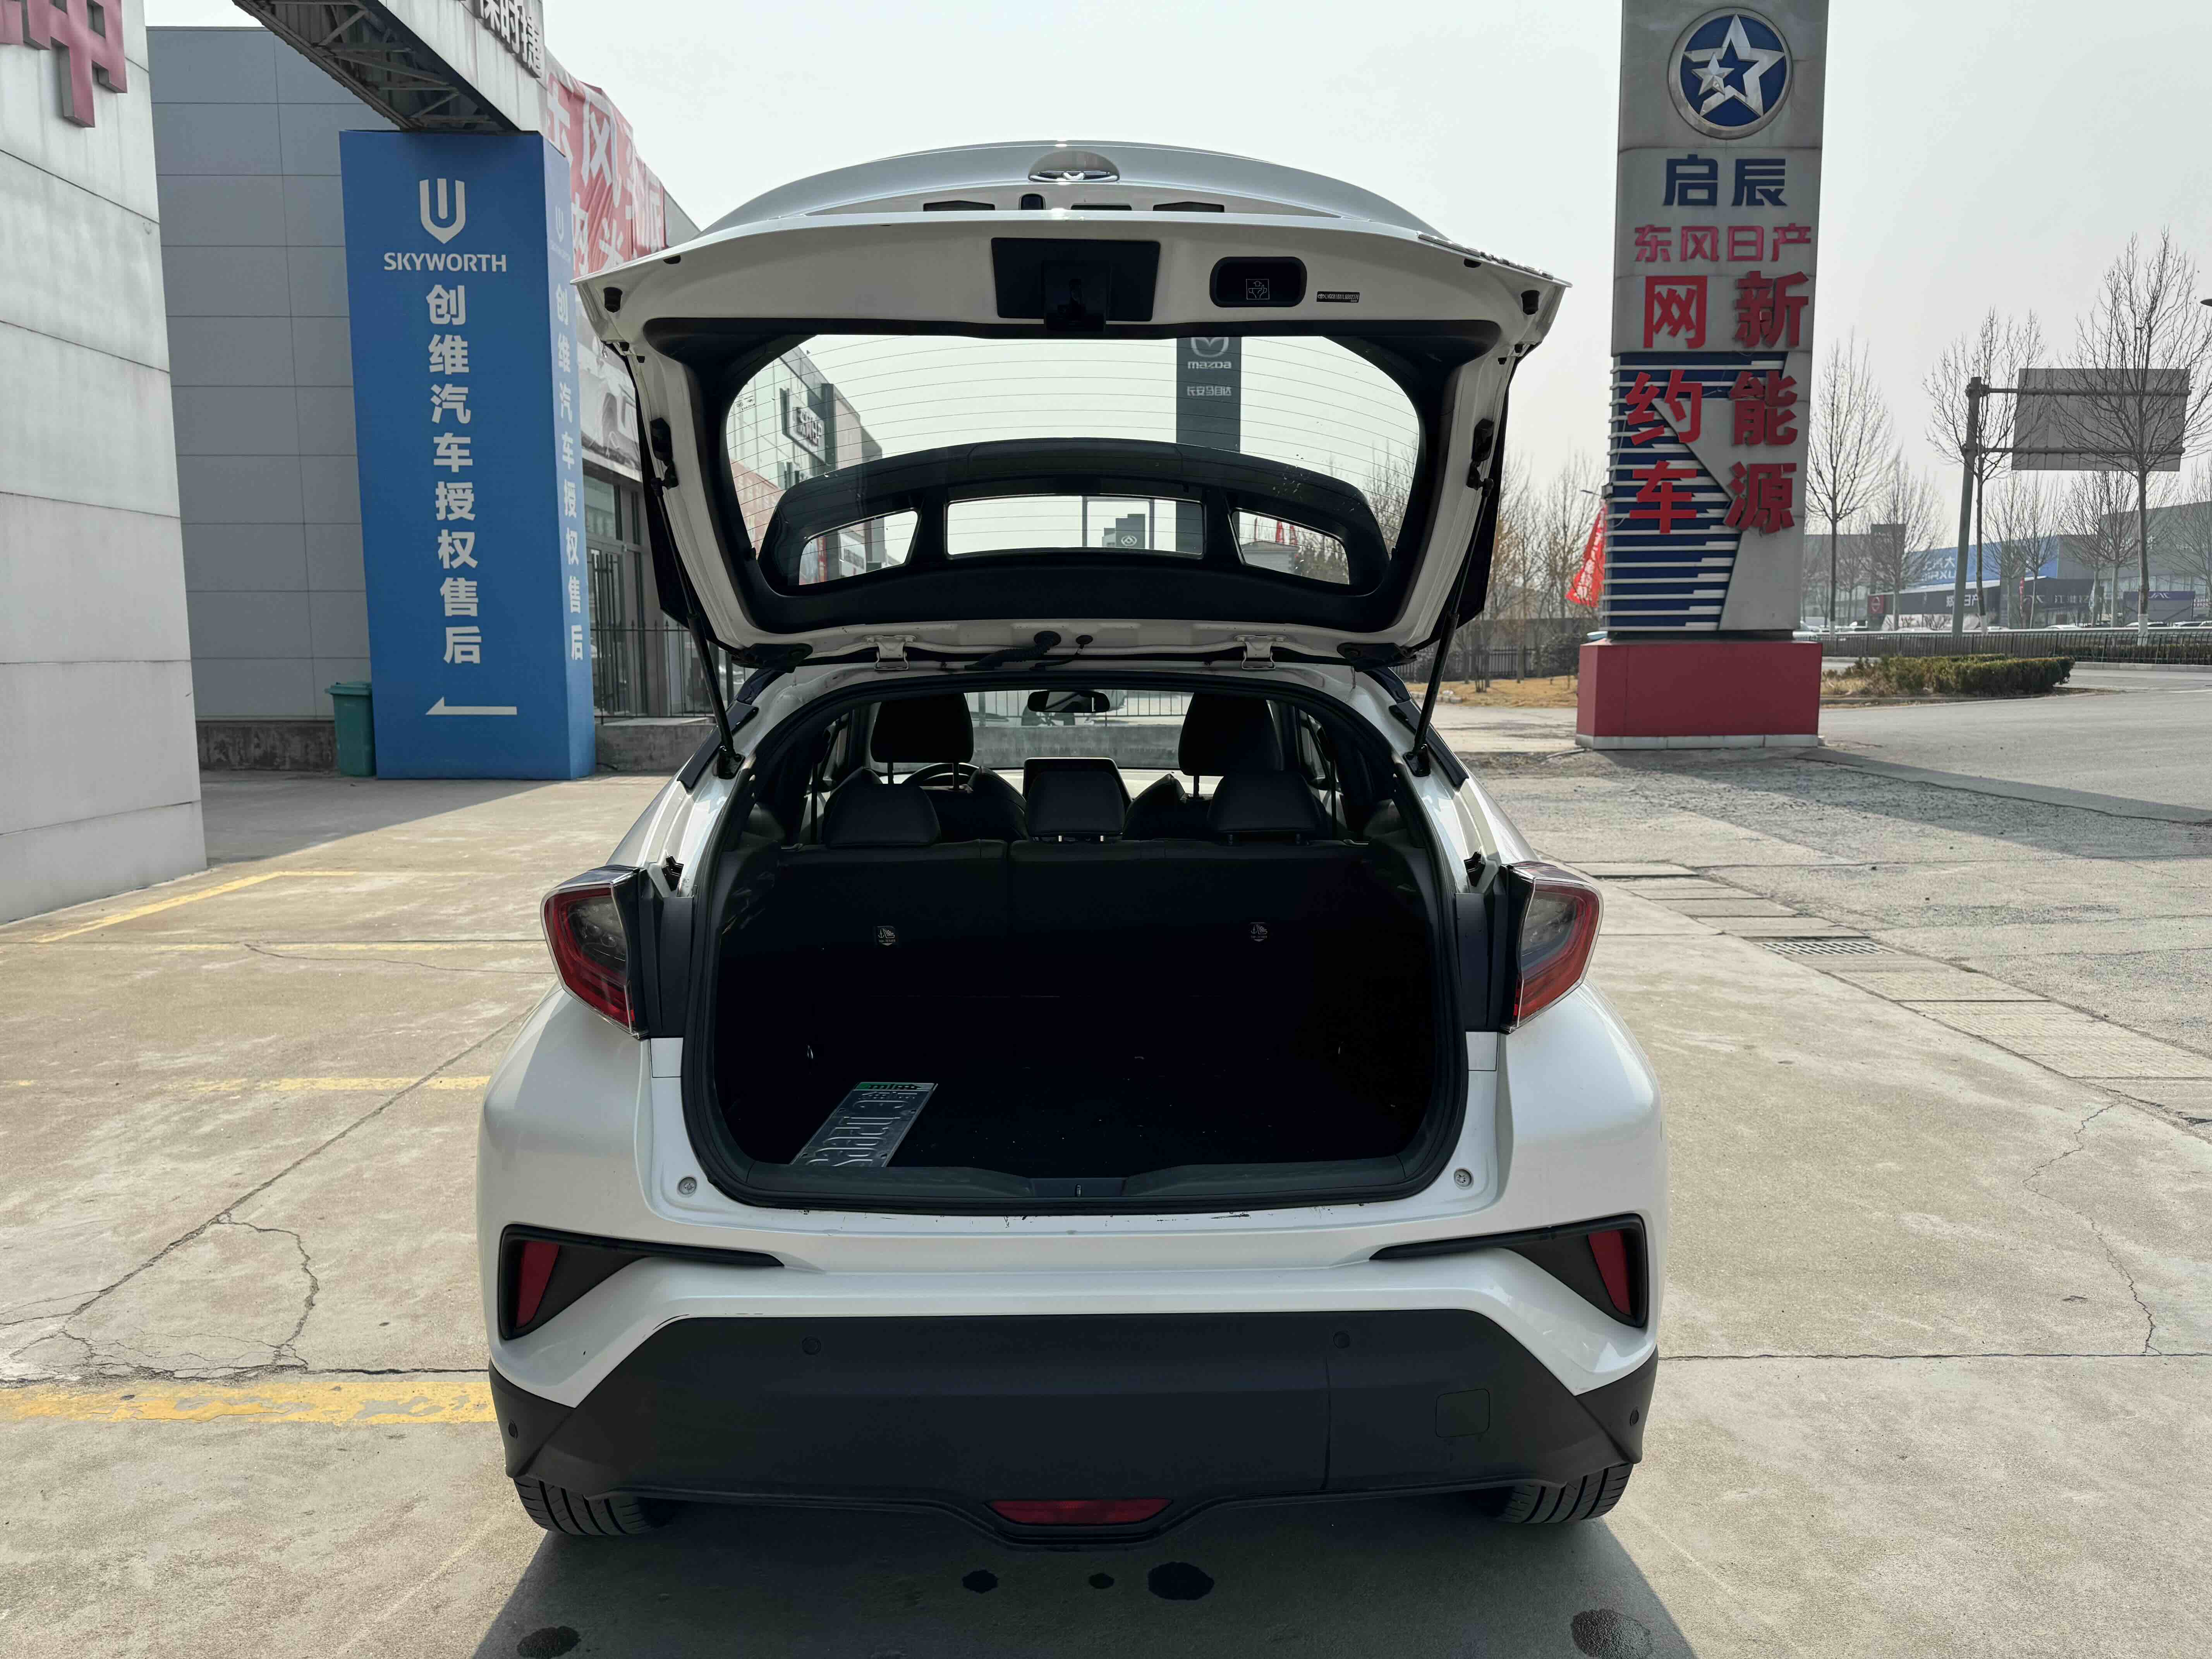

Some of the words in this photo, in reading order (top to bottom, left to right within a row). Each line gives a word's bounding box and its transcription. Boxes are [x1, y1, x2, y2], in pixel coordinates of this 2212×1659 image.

[1634, 223, 1811, 263] 东风日产
[1662, 154, 1788, 206] 启辰
[384, 252, 507, 272] SKYWORTH
[1187, 386, 1232, 396] 长安马自达
[1625, 275, 1707, 534] 网约车
[1724, 270, 1809, 534] 新能源
[426, 284, 482, 664] 创维汽车授权售后
[555, 284, 583, 661] 创维汽车授权售后
